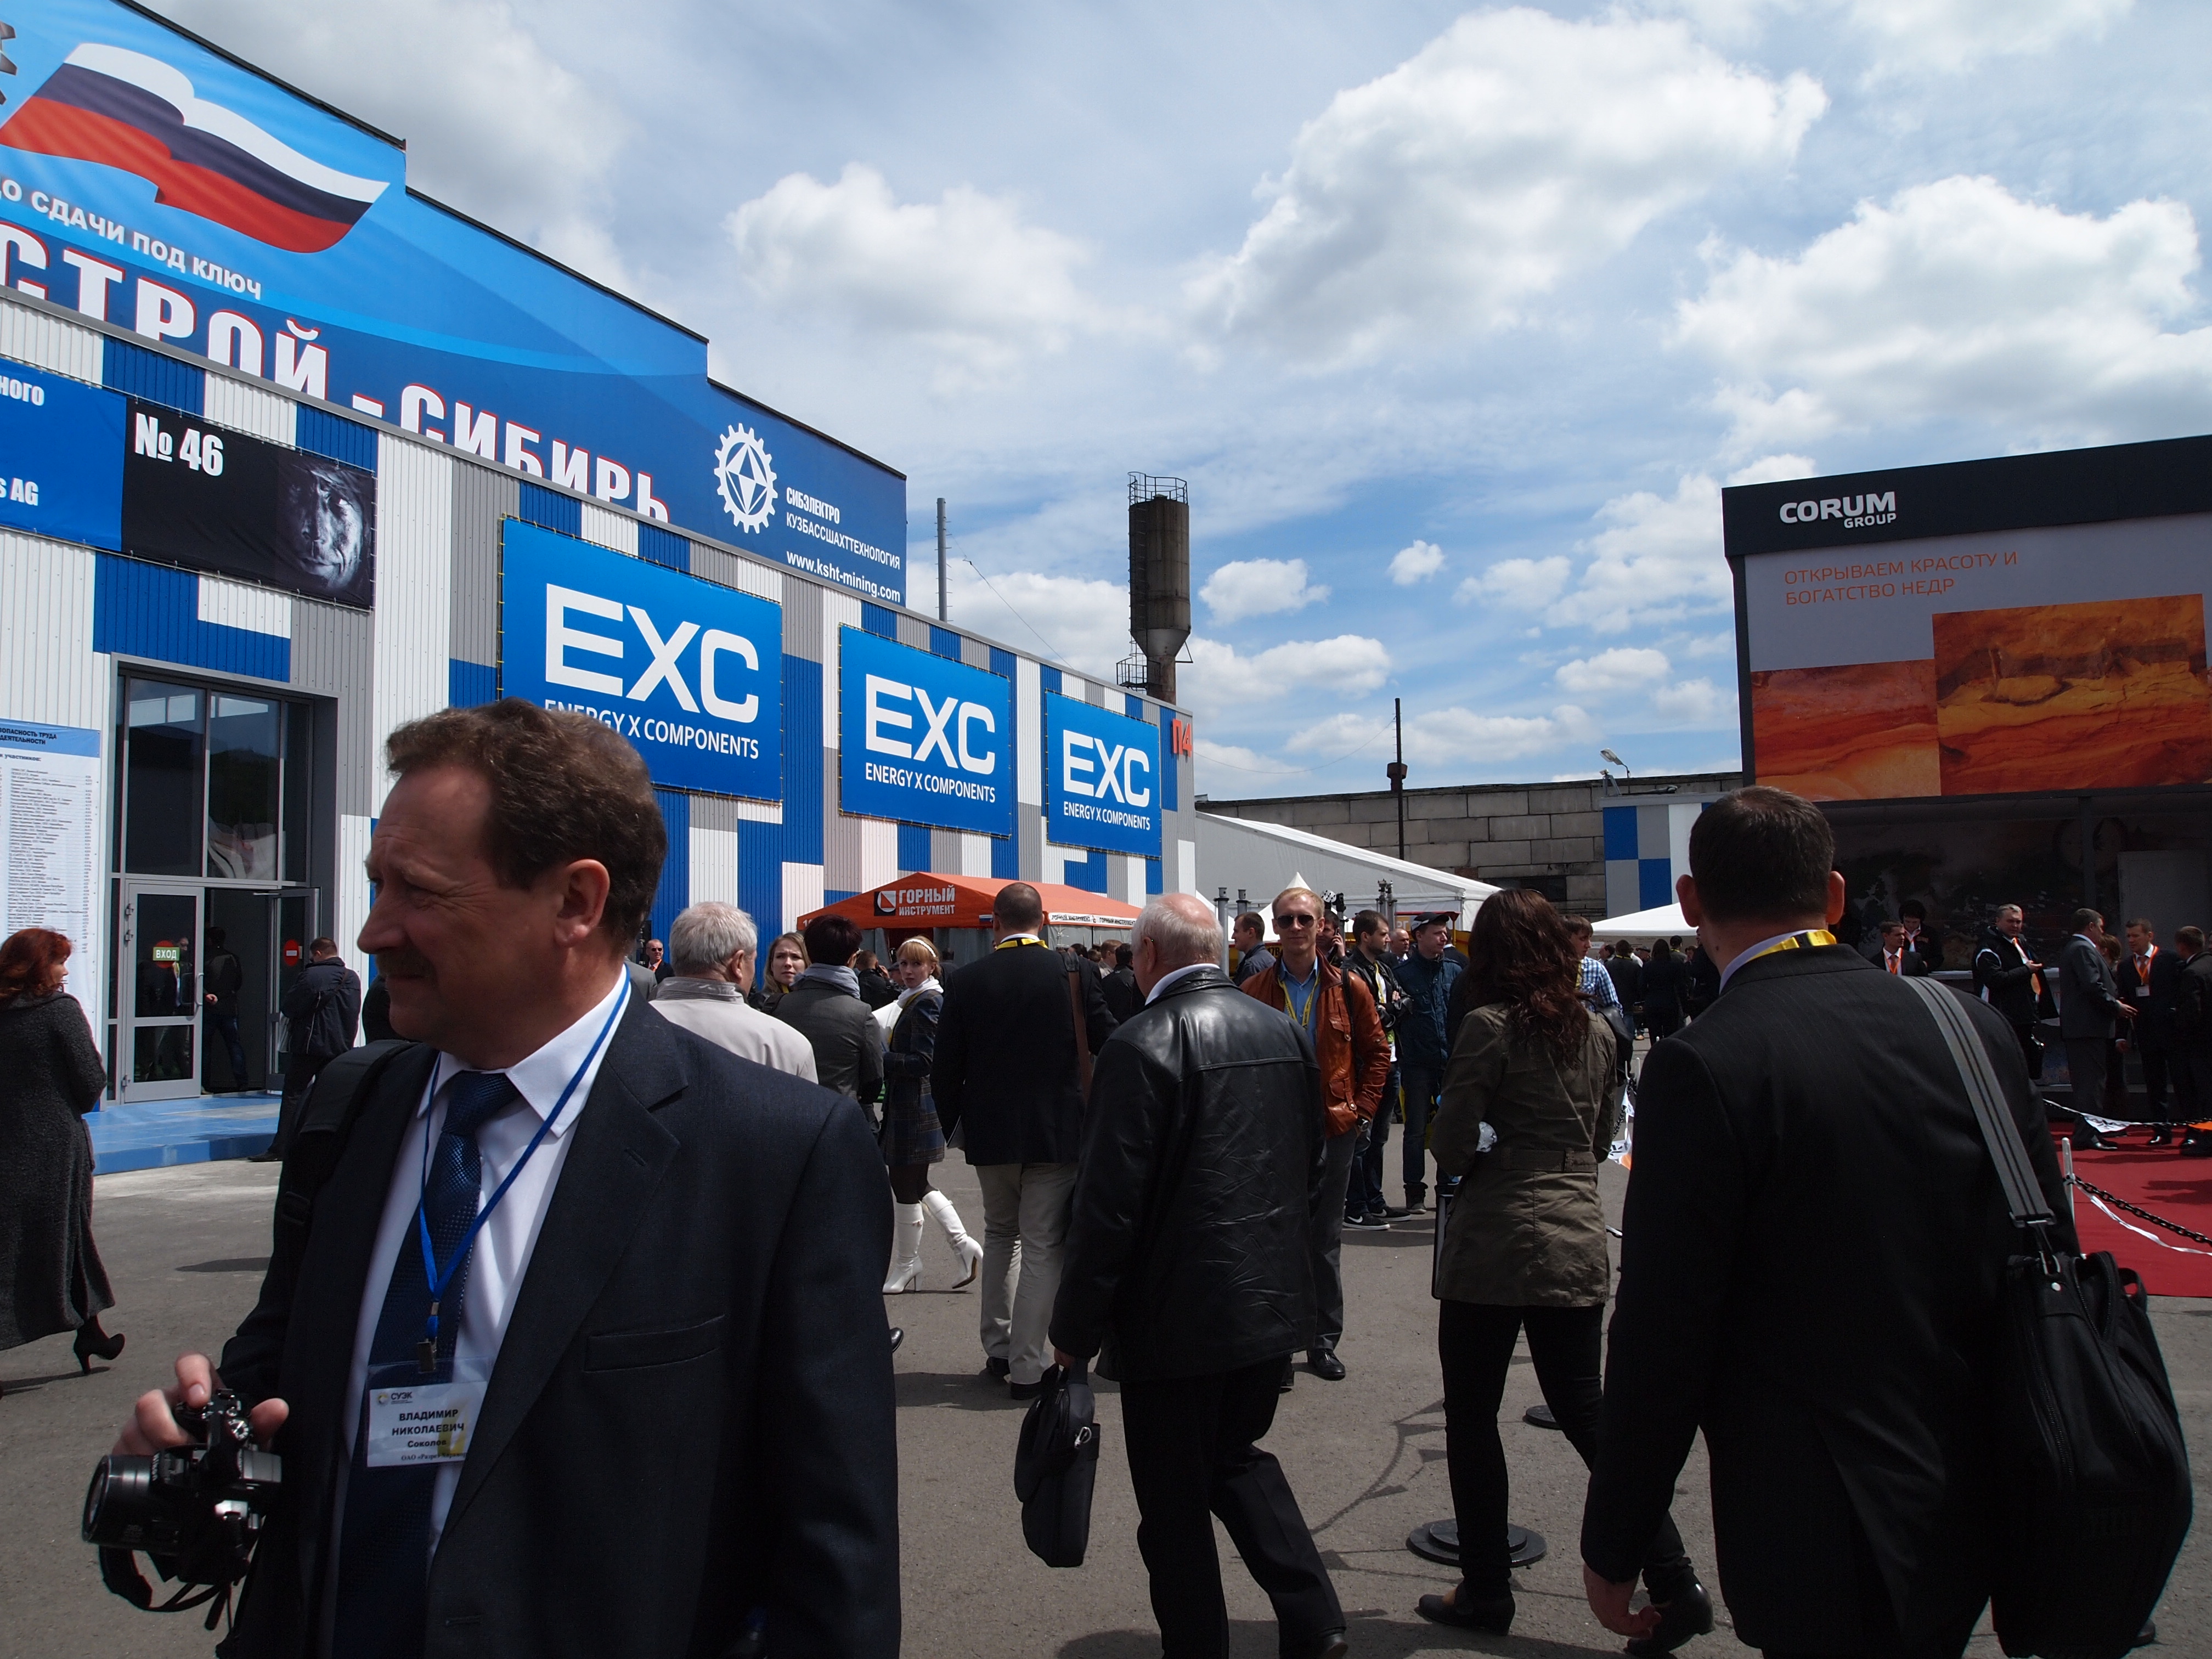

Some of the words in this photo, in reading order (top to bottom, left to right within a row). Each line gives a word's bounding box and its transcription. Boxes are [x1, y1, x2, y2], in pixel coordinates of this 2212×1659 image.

[0, 179, 22, 201] О
[32, 191, 125, 245] СДАЧИ
[133, 231, 185, 273] ПОД
[193, 257, 262, 301] КЛЮЧ
[179, 427, 224, 476] 46
[10, 477, 39, 506] AG
[787, 487, 840, 524] СИБЭЛЕКТРО
[1779, 492, 1895, 524] CORUM
[1844, 512, 1897, 528] GROUP
[787, 511, 900, 570] КУЗБАССШАХТТЕХНОЛОГИЯ
[787, 551, 901, 603] www.ksht-mining.com
[1784, 561, 1904, 585] ОТКРЫВАЕМ
[1911, 552, 1997, 573] КРАСОТУ
[2004, 551, 2018, 566] И
[1786, 583, 1895, 605] БОГАТСТВО
[1902, 578, 1955, 596] НЕДР
[545, 583, 759, 724] EXC
[0, 735, 46, 744] ДЕЯТЕЛЬНОСТИ
[628, 715, 641, 738] X
[644, 718, 759, 759] COMPONENTS
[866, 673, 995, 775] EXC
[866, 762, 913, 788] ENERGY
[915, 771, 923, 787] X
[924, 774, 996, 803] COMPONENTS
[1063, 729, 1150, 808] EXC
[1063, 801, 1095, 822] ENERGY
[1096, 807, 1102, 821] X
[1102, 809, 1150, 831] COMPONENTS
[899, 884, 955, 904] ГОРНЫЙ
[899, 904, 955, 916] ИНСТРУМЕНТ
[156, 950, 177, 960] ВХОД
[391, 1391, 413, 1400] СУЭК
[392, 1423, 464, 1436] НИКОЛАЕВИЧ
[399, 1409, 458, 1421] ВЛАДИМИР
[408, 1440, 447, 1448] Соколов
